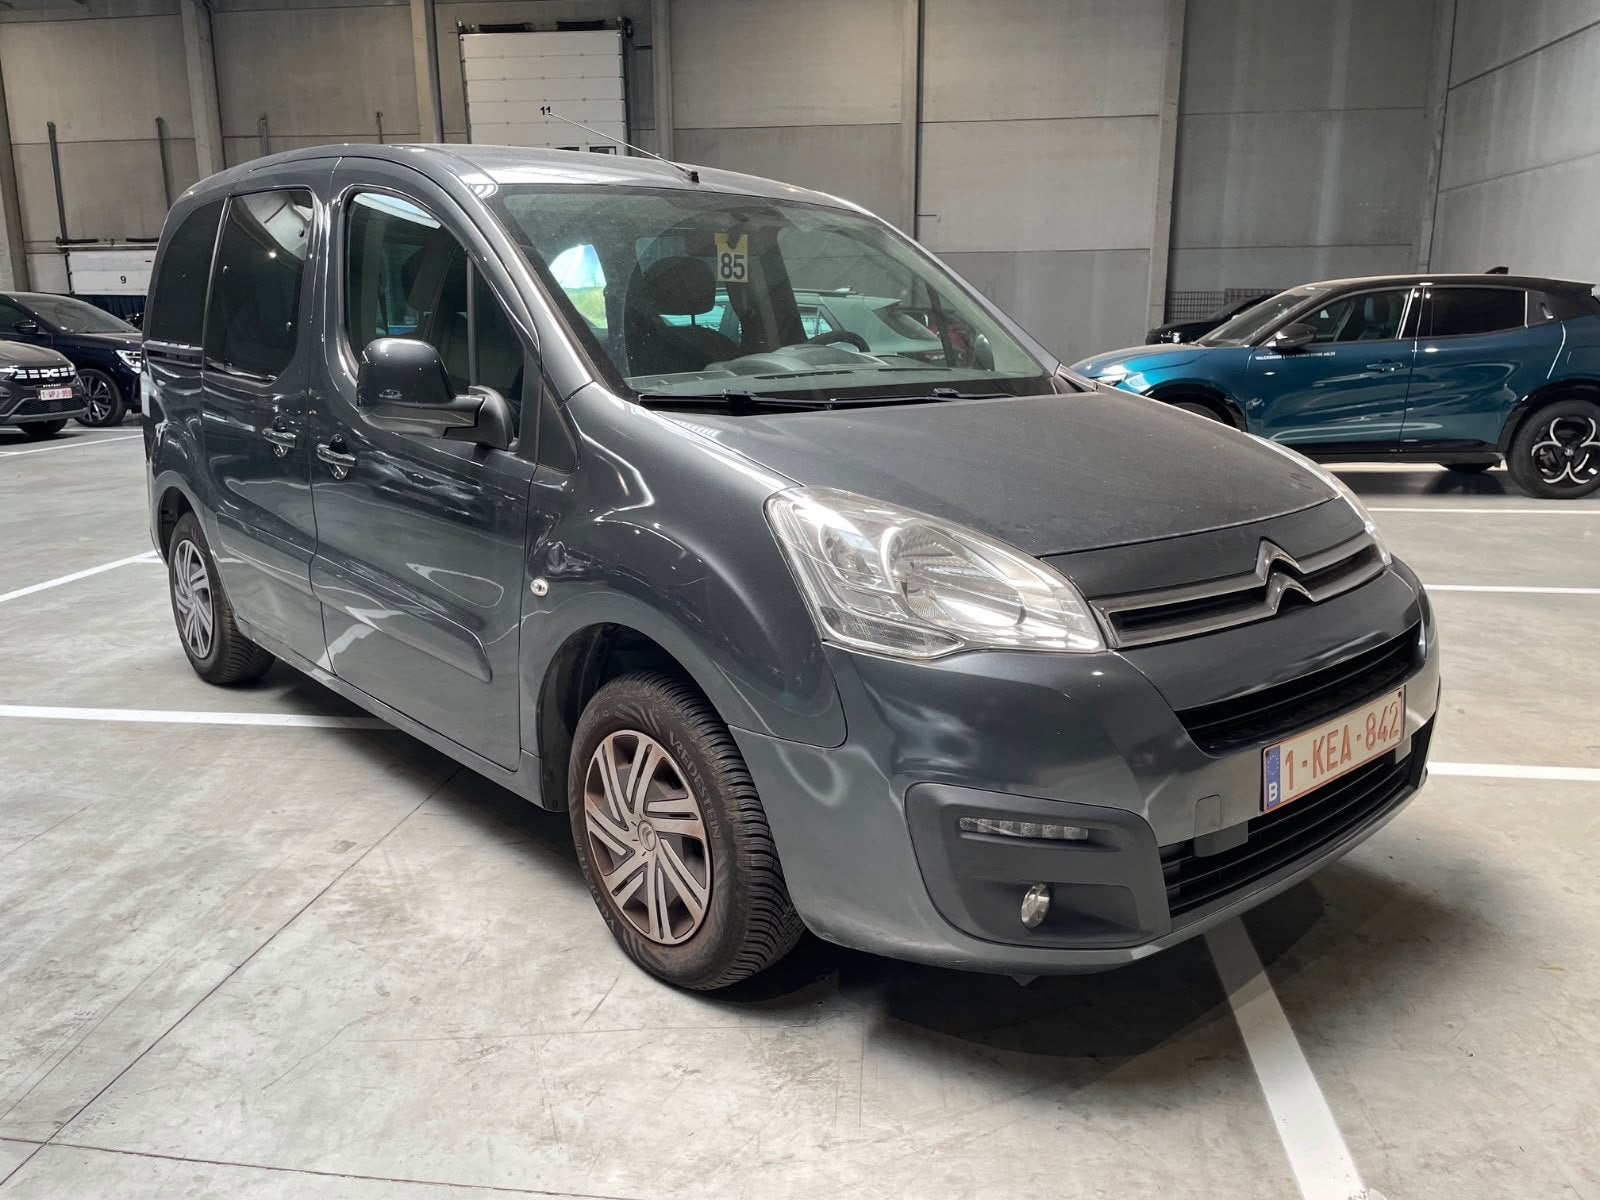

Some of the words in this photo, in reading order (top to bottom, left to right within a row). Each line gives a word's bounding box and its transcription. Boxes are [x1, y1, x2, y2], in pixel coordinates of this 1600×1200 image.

[539, 106, 551, 116] 11
[720, 252, 746, 280] 85
[120, 275, 127, 285] 9
[1285, 701, 1399, 791] 1-KEA-842
[1268, 782, 1278, 802] B
